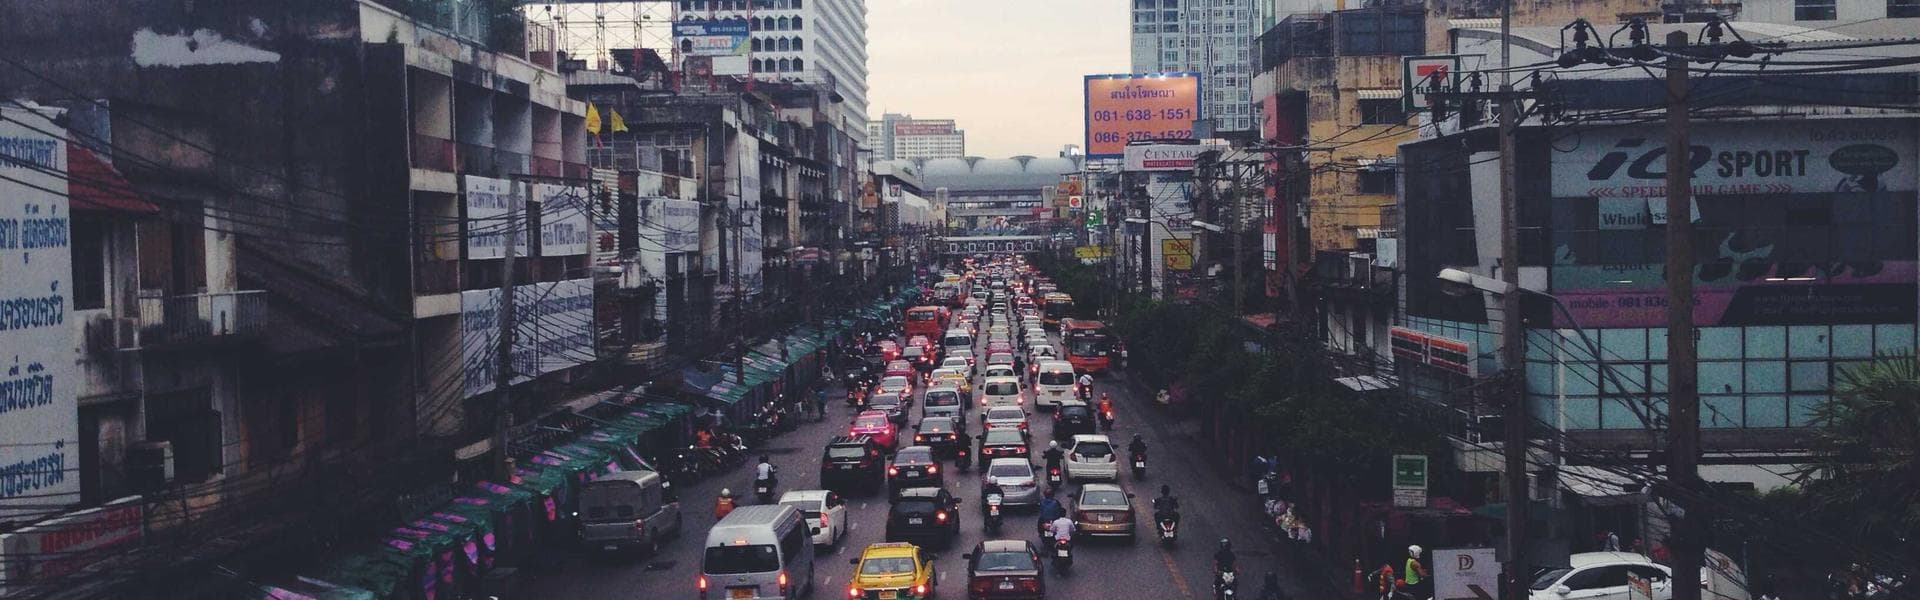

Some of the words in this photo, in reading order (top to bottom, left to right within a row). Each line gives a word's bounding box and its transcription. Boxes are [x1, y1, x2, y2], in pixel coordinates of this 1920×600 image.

[1094, 109, 1192, 122] 081-638-1551
[1717, 149, 1811, 178] SPORT
[1718, 184, 1761, 195] GAME
[1569, 297, 1609, 309] mobile
